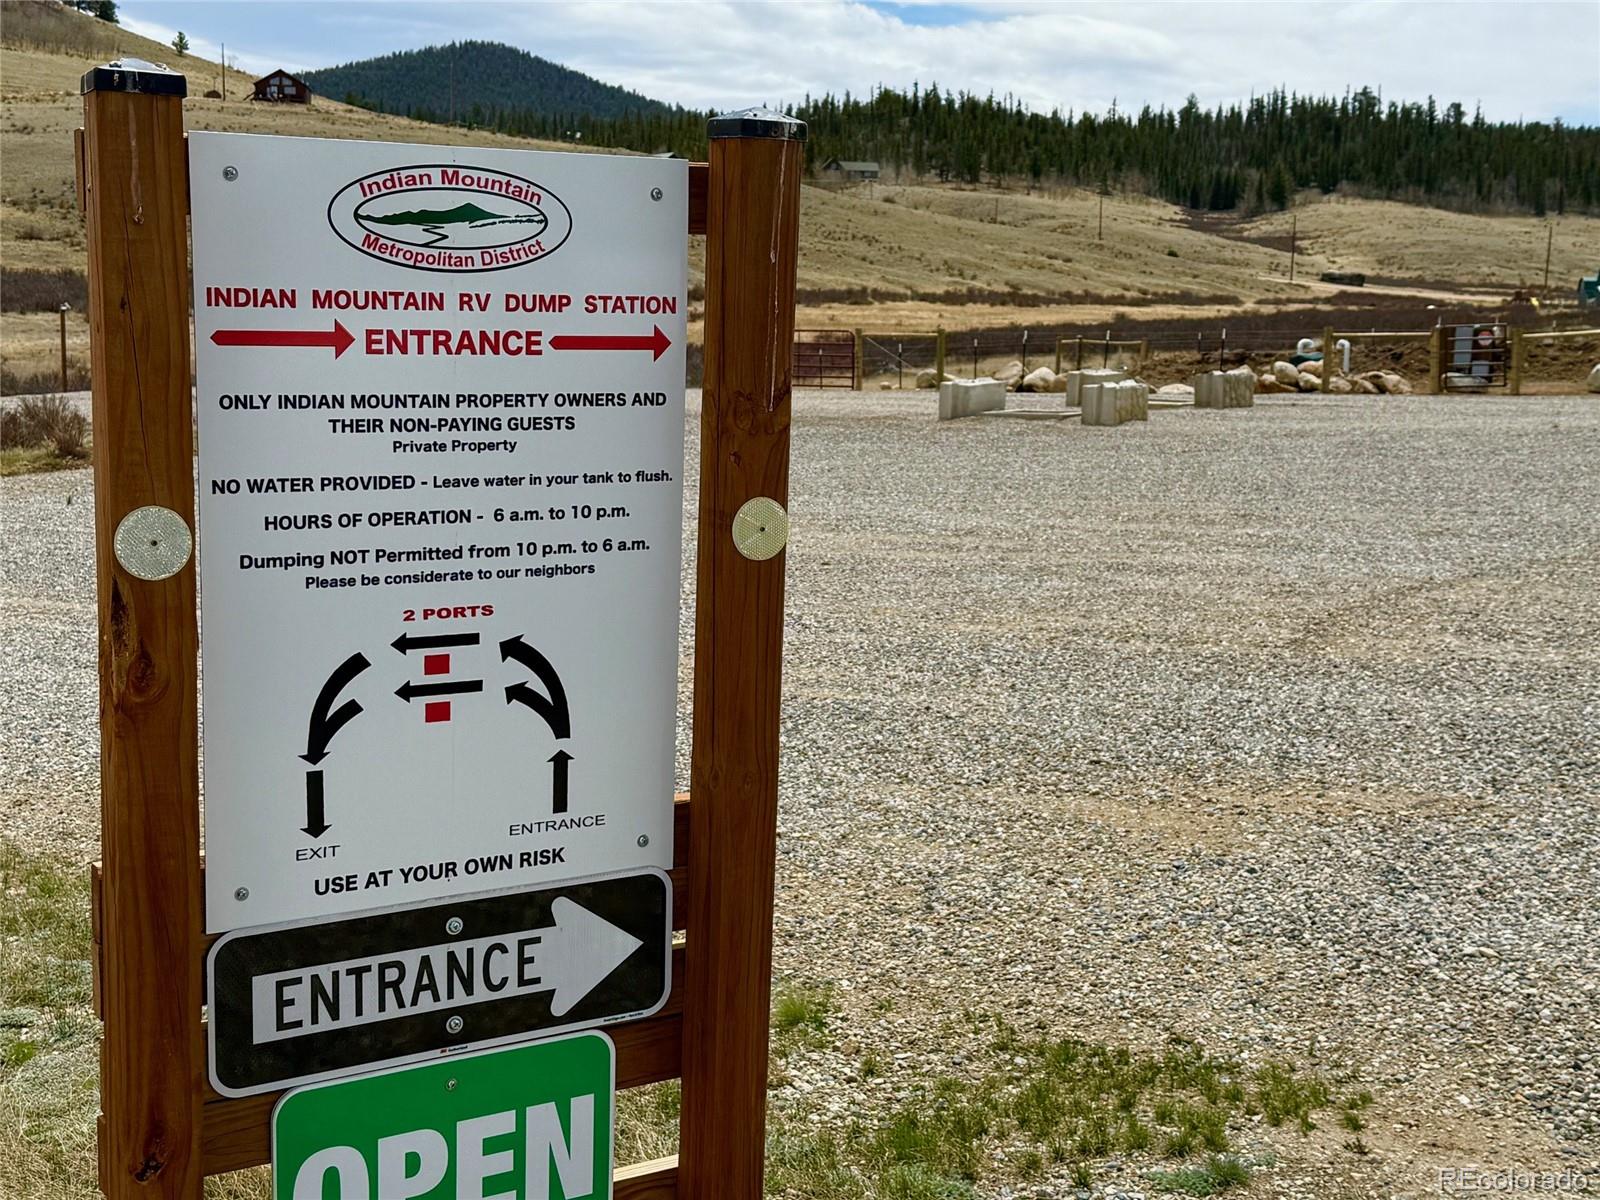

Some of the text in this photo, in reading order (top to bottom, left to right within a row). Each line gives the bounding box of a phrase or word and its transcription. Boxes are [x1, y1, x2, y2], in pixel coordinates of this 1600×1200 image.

[359, 169, 543, 205] Indian Mountain
[361, 233, 546, 268] Metropolitan District
[207, 288, 677, 314] INDIAN MOUNTAIN RV DUMP STATION
[365, 329, 543, 357] ENTRANCE
[219, 392, 666, 410] ONLY INDIAN MOUNTAIN PROPERTY OWNERS AND
[328, 416, 575, 433] THEIR NON-PAYING GUESTS
[393, 440, 517, 453] Private Property
[212, 479, 240, 495] NO
[246, 478, 314, 493] WATER
[321, 475, 415, 491] PROVIDED
[433, 476, 479, 488] Leave
[484, 475, 525, 487] water
[530, 474, 542, 485] in
[546, 475, 579, 487] your
[582, 472, 613, 484] tank
[617, 472, 631, 483] to
[635, 470, 672, 482] flush.
[265, 514, 332, 531] HOURS
[338, 513, 362, 528] OF
[368, 509, 471, 527] OPERATION
[494, 508, 504, 522] 6
[510, 510, 543, 521] a.m.
[548, 507, 565, 520] to
[572, 505, 591, 519] 10
[597, 507, 630, 520] p.m.
[240, 539, 650, 570] Dumping NOT Permitted from 10 p.m. to 6 a.m.
[306, 564, 595, 589] Please be considerate to our neighbors
[404, 605, 493, 622] 2 PORTS
[508, 814, 606, 836] ENTRANCE
[296, 845, 340, 861] EXIT
[315, 847, 565, 895] USE AT YOUR OWN RISK
[275, 936, 542, 1032] ENTRANCE
[292, 1093, 595, 1200] OPEN
